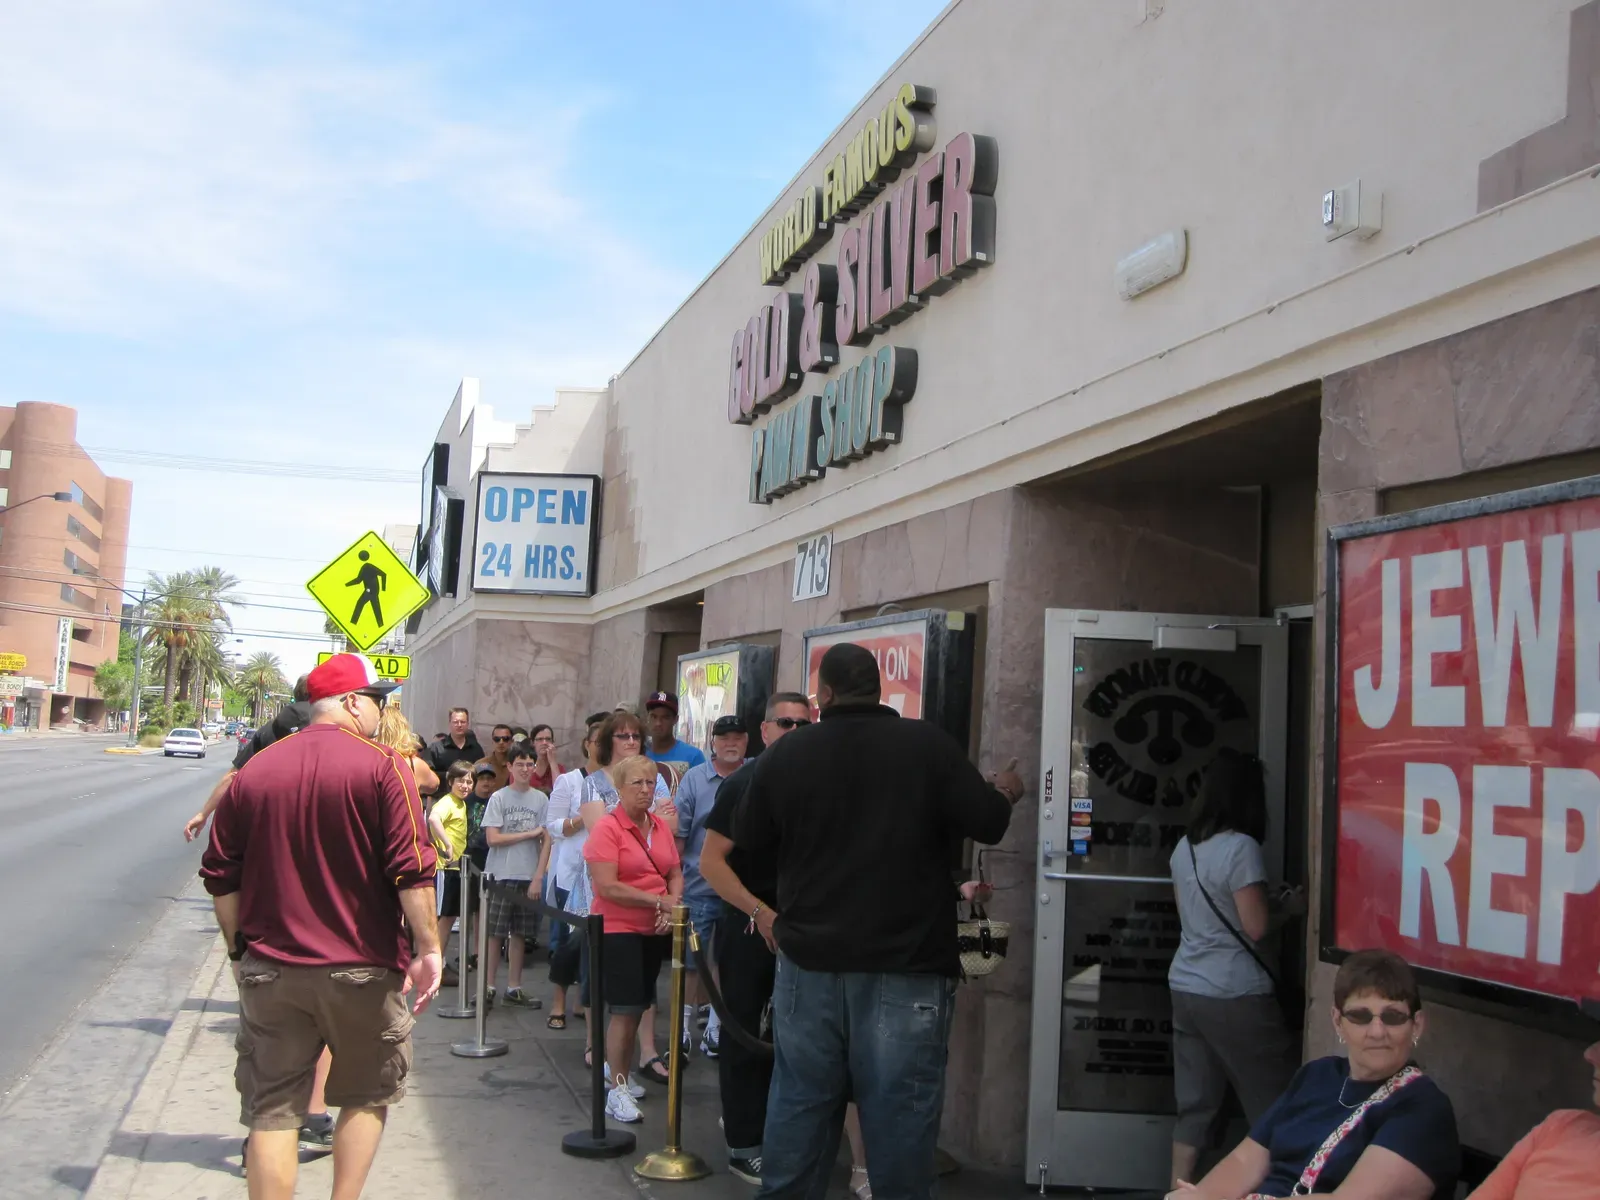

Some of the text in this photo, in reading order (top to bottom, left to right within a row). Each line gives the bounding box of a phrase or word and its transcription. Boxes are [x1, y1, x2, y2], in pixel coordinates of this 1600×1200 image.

[759, 82, 920, 286] WORLD FAMOUS
[727, 131, 980, 425] GOLD & SILVER
[748, 344, 897, 504] PAWN SHOP
[484, 486, 587, 525] OPEN
[480, 542, 582, 580] 24 HRS.
[796, 534, 829, 597] 713
[885, 646, 910, 681] ON
[1045, 773, 1053, 796] USH
[1073, 802, 1092, 810] VISA
